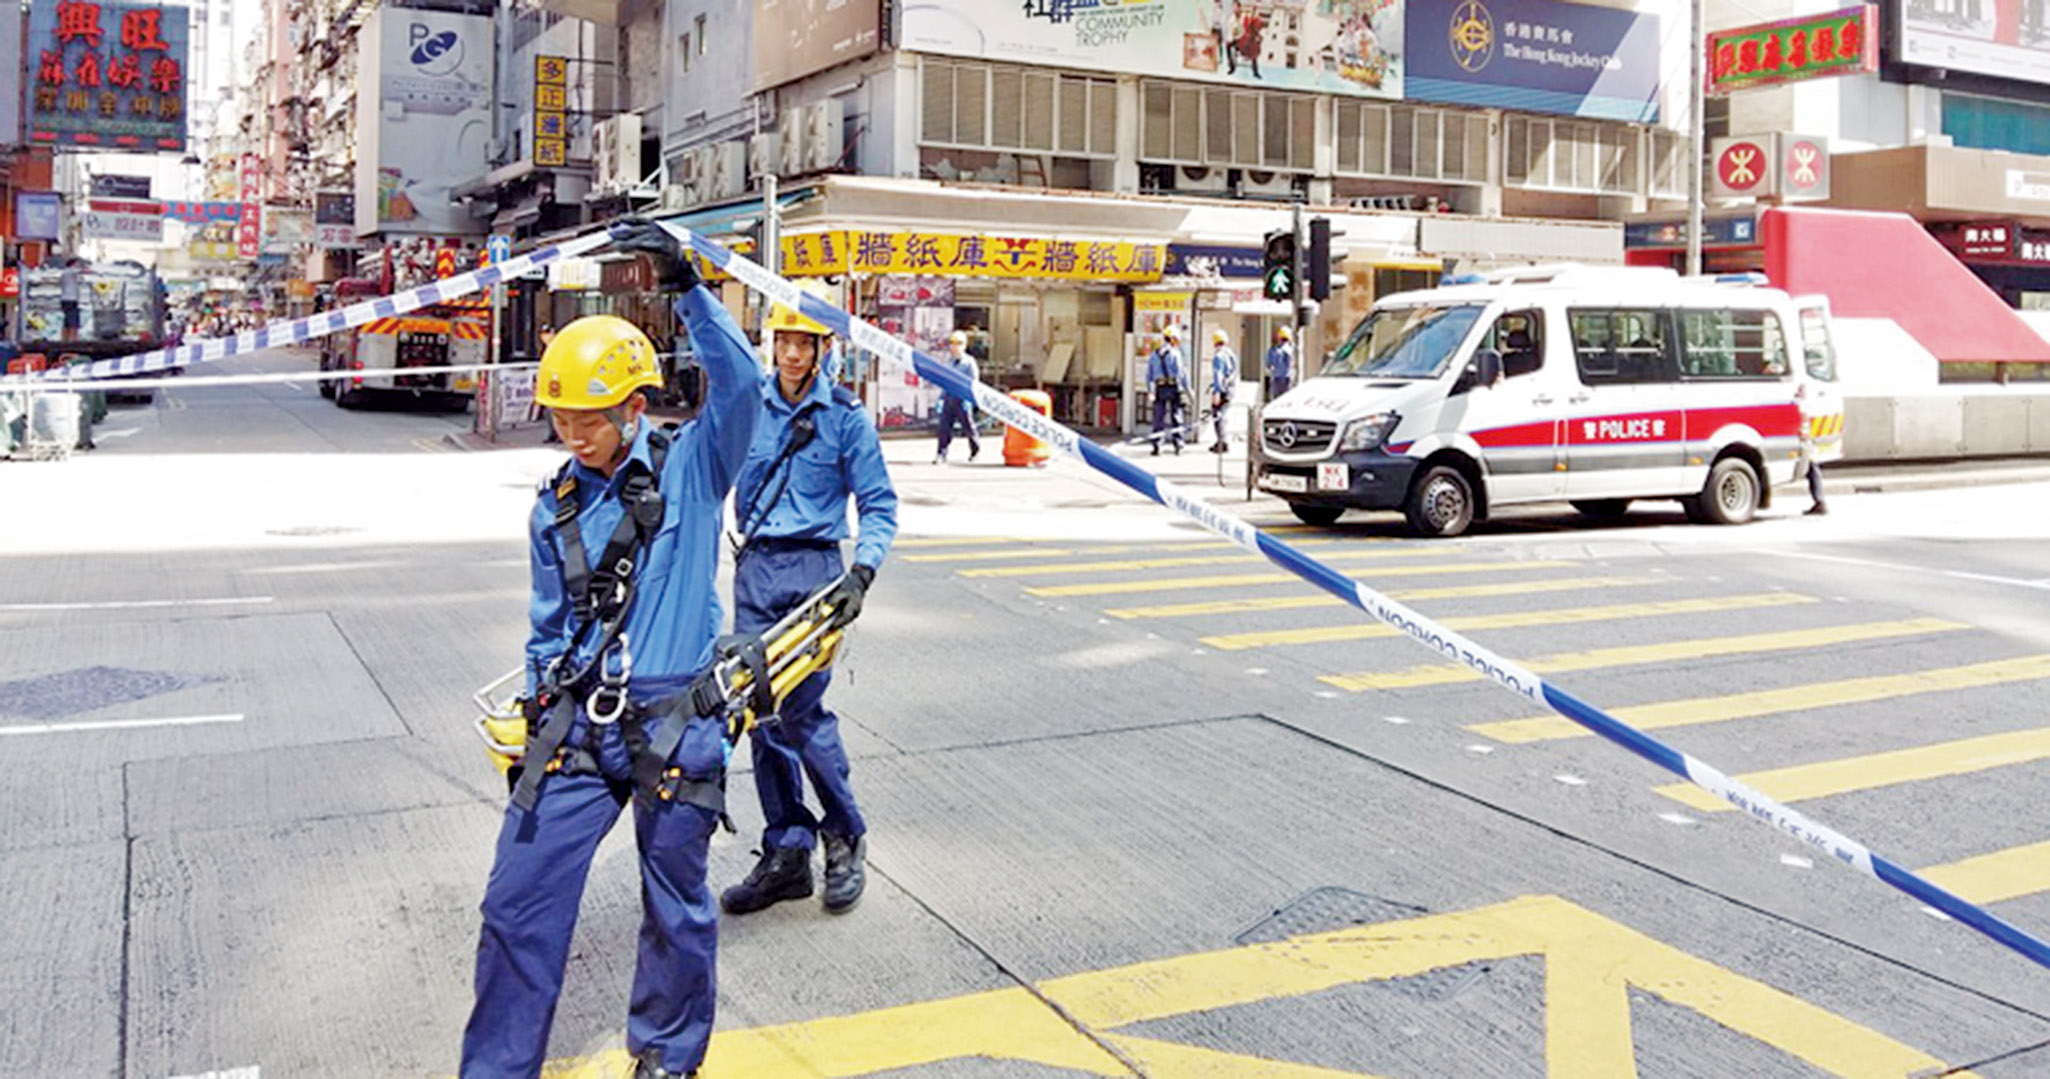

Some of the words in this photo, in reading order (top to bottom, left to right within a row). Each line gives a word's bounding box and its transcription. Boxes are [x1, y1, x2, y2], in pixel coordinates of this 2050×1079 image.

[53, 1, 170, 51] 興旺
[1075, 12, 1164, 31] COMMUNITY
[1075, 31, 1127, 46] TROPHY
[781, 234, 838, 270] 紙庫
[1600, 419, 1650, 438] POLICE
